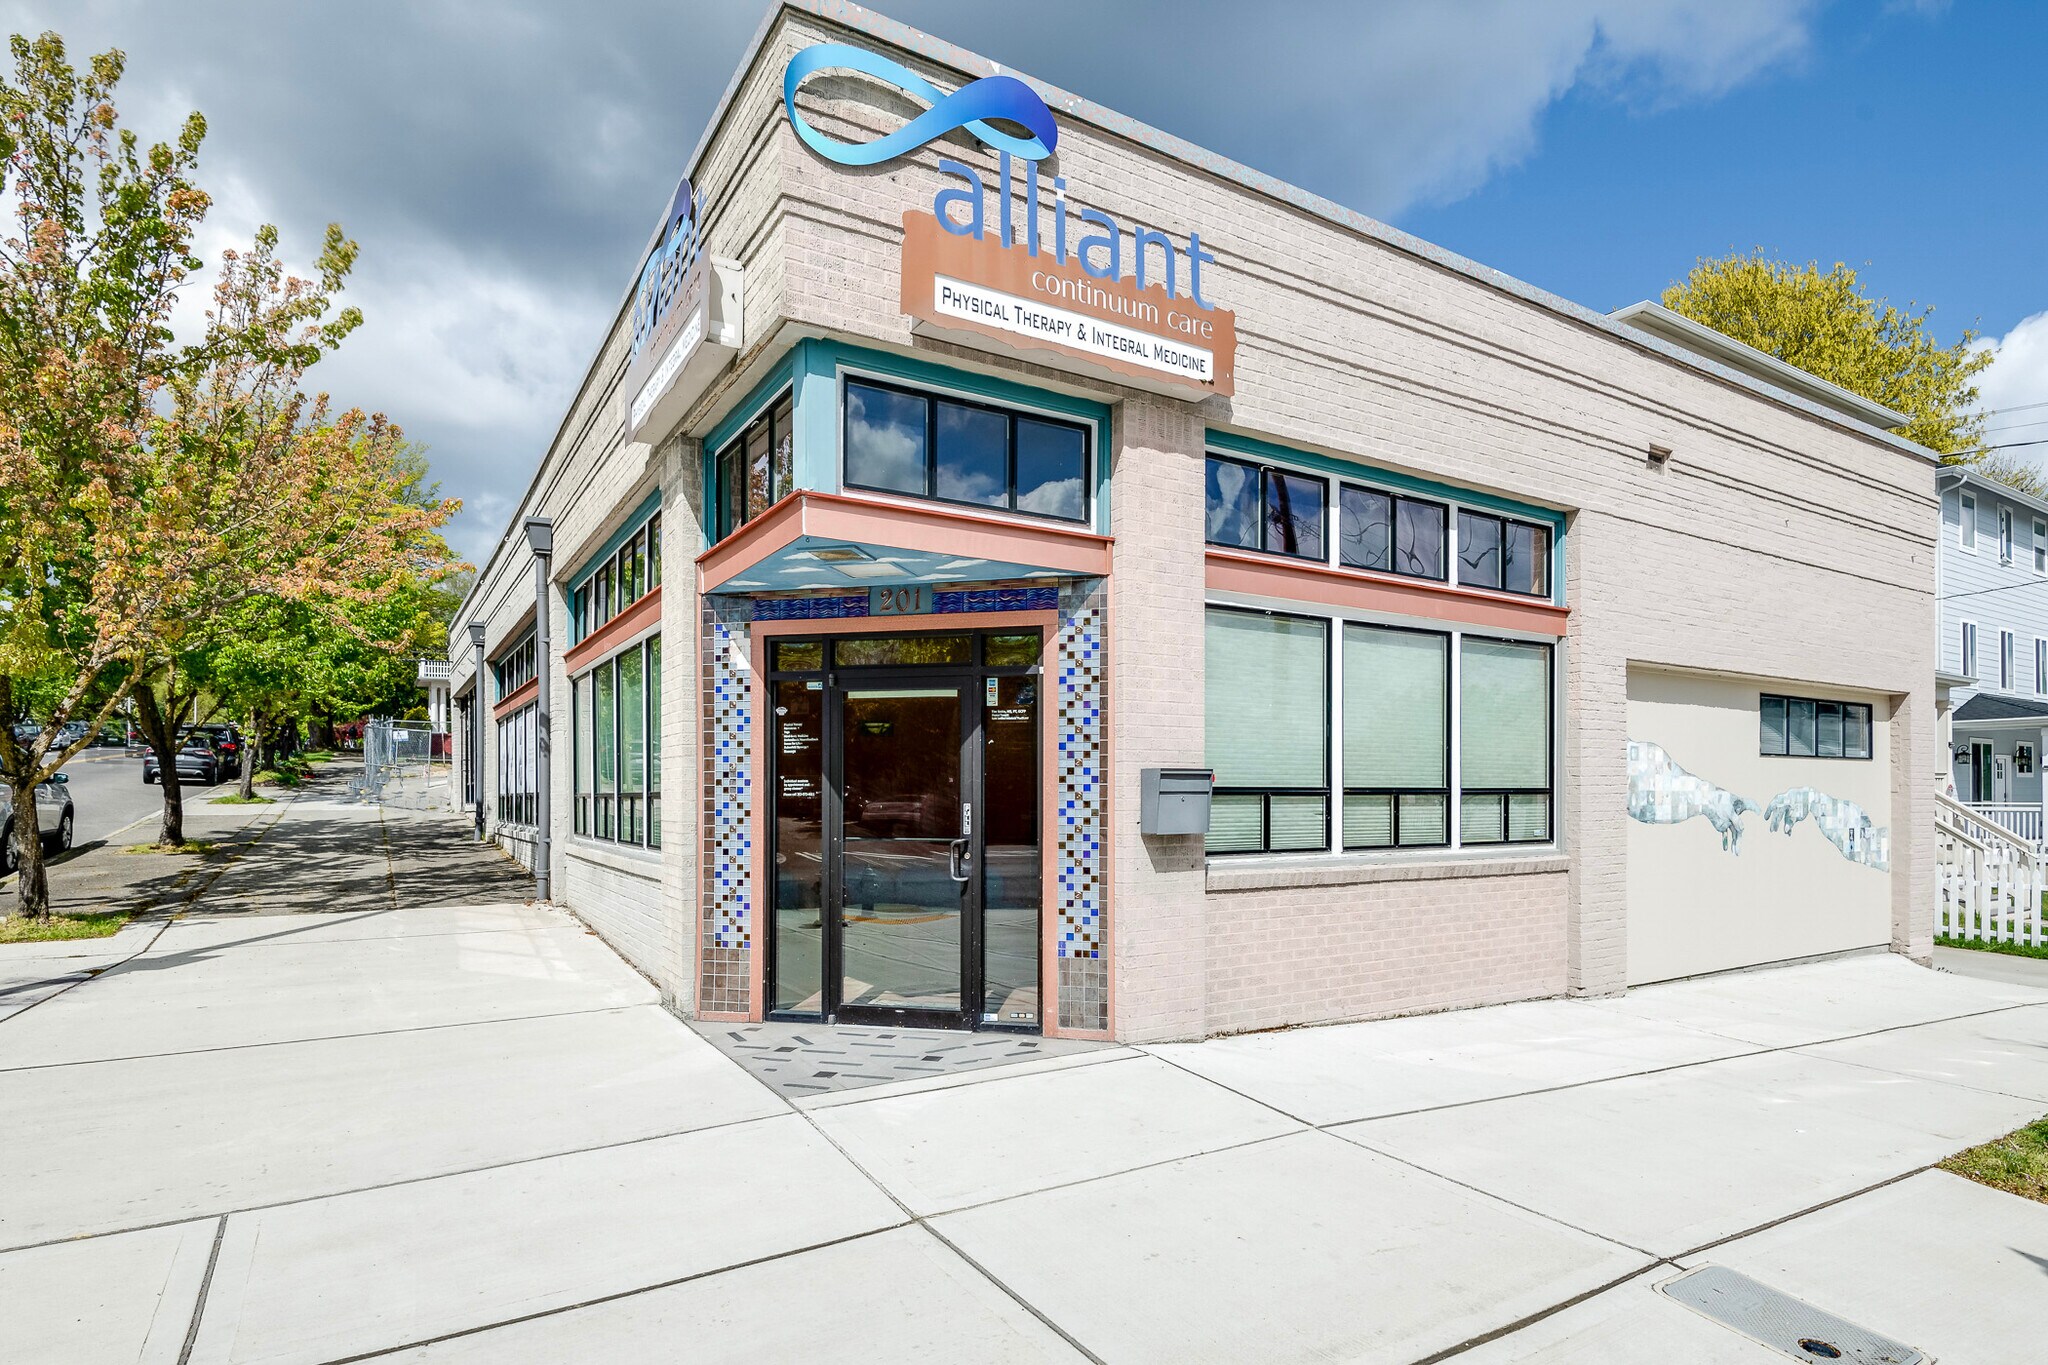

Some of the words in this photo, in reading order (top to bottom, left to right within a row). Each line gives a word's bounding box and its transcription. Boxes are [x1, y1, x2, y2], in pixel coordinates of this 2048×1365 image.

[933, 151, 1215, 311] alliant
[942, 286, 1009, 321] PHYSICAL
[1014, 305, 1072, 337] THERAPY
[1077, 323, 1087, 342] &
[1092, 327, 1149, 358] INTEGRAL
[1154, 343, 1206, 373] MEDICINE
[1032, 271, 1159, 325] continuum
[1167, 310, 1213, 339] care
[880, 588, 921, 611] 201
